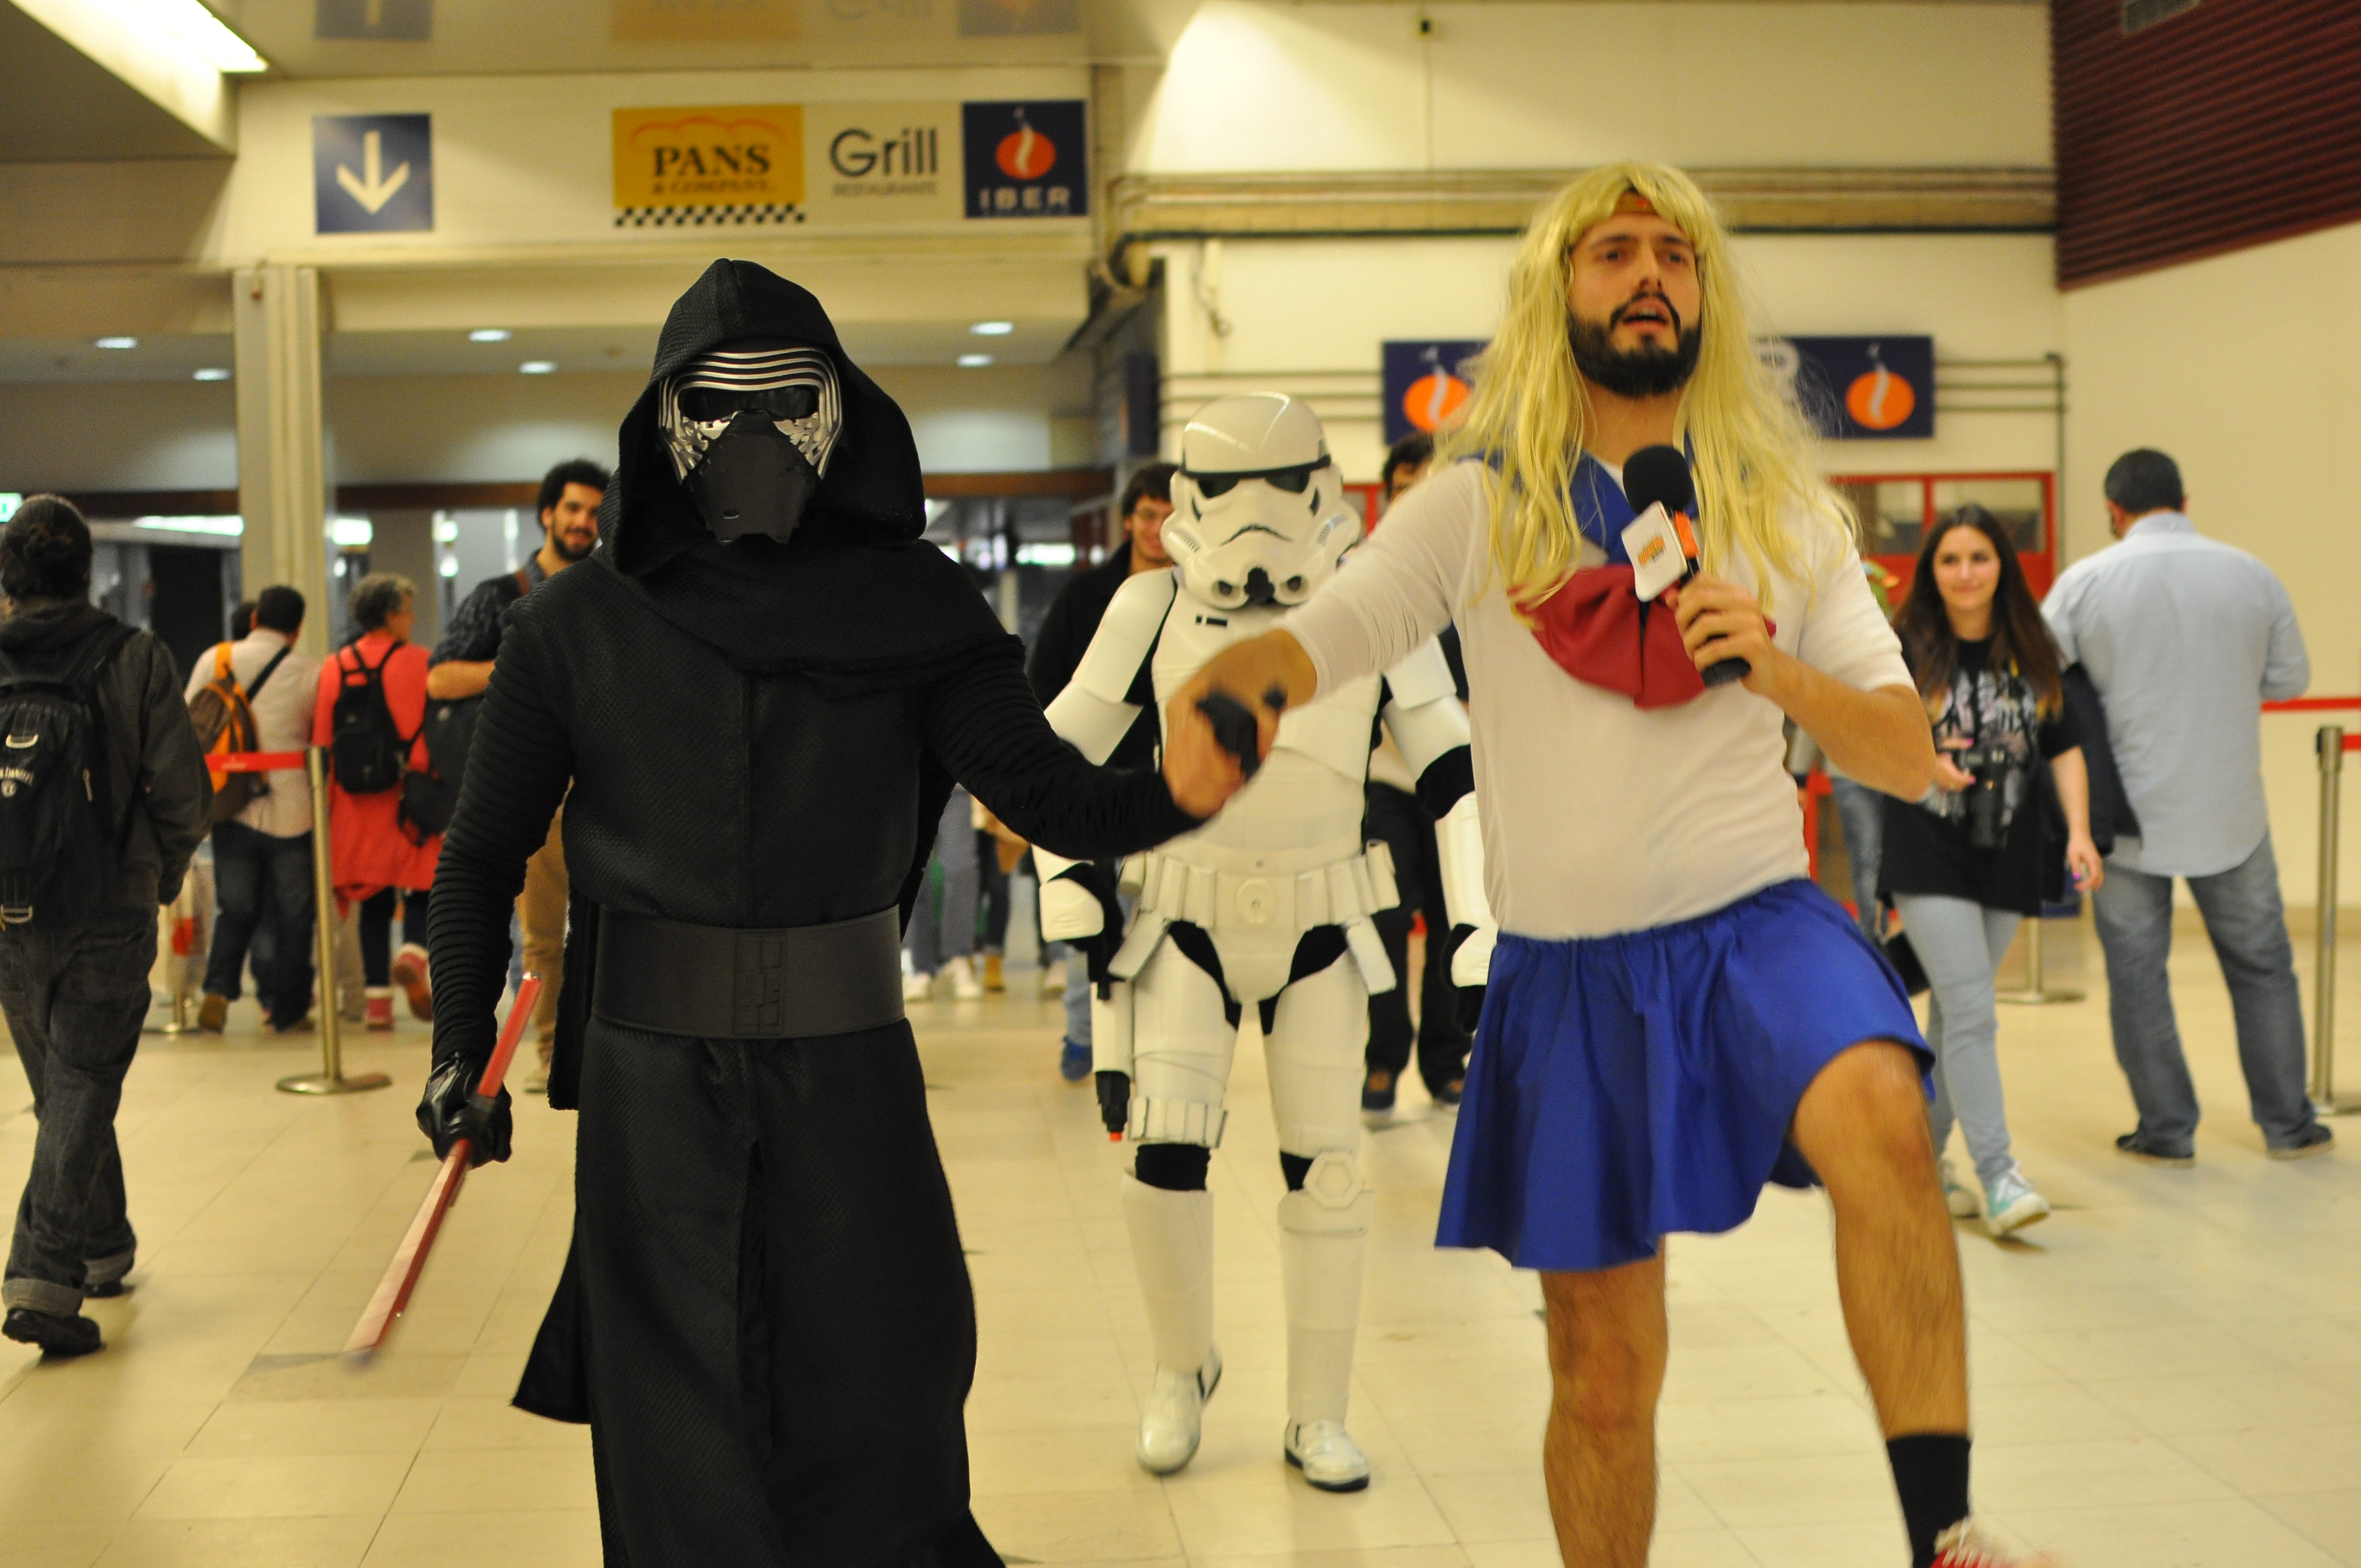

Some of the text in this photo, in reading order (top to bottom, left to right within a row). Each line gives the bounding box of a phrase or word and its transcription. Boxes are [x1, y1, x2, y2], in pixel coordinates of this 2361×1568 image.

[654, 145, 770, 177] PANS
[830, 126, 938, 177] Grill
[979, 186, 1070, 209] IBER
